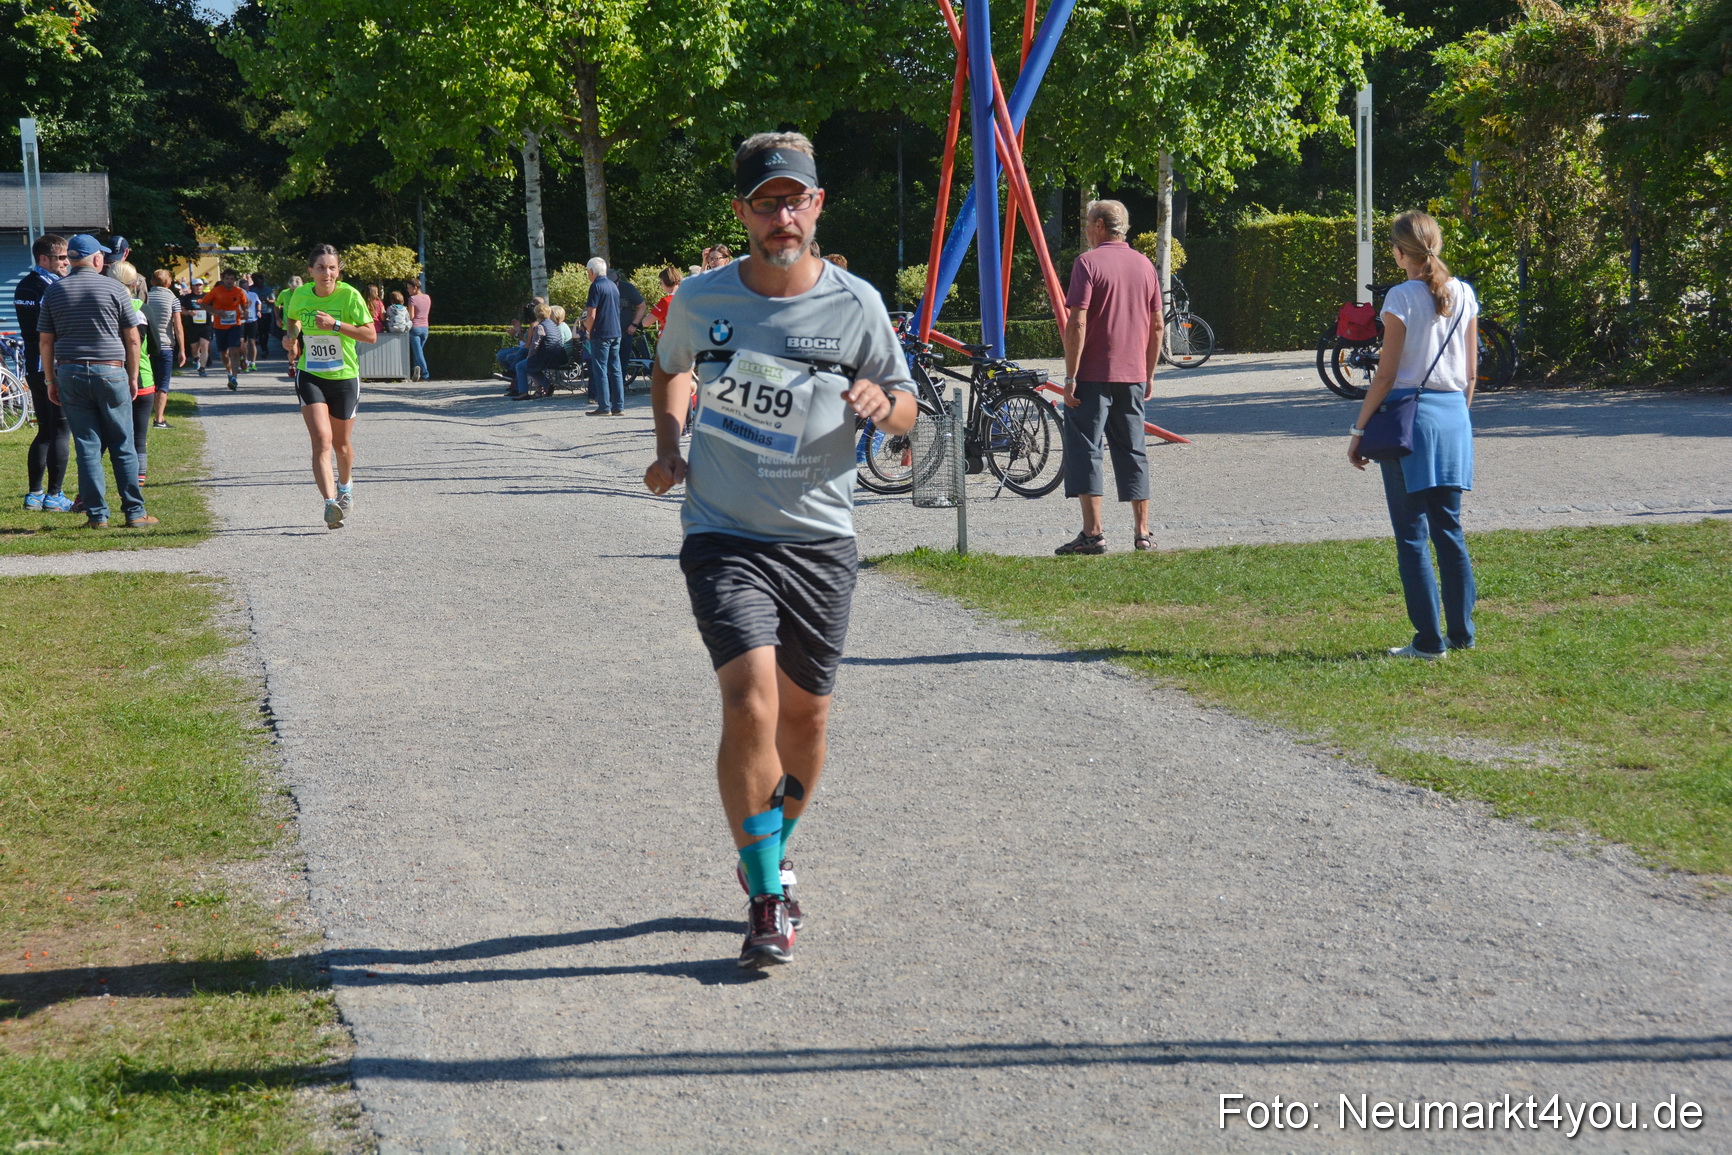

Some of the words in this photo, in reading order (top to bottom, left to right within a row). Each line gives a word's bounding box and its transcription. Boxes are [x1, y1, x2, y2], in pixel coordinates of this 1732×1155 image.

[311, 344, 337, 357] 3016
[786, 336, 841, 350] BOCK
[738, 360, 784, 380] BOCK
[717, 376, 793, 418] 2159
[721, 406, 742, 416] PARTL
[743, 413, 773, 427] Neumarkt
[722, 416, 774, 446] Matthias
[757, 454, 822, 466] Neurkter
[758, 467, 810, 479] Stadtlauf
